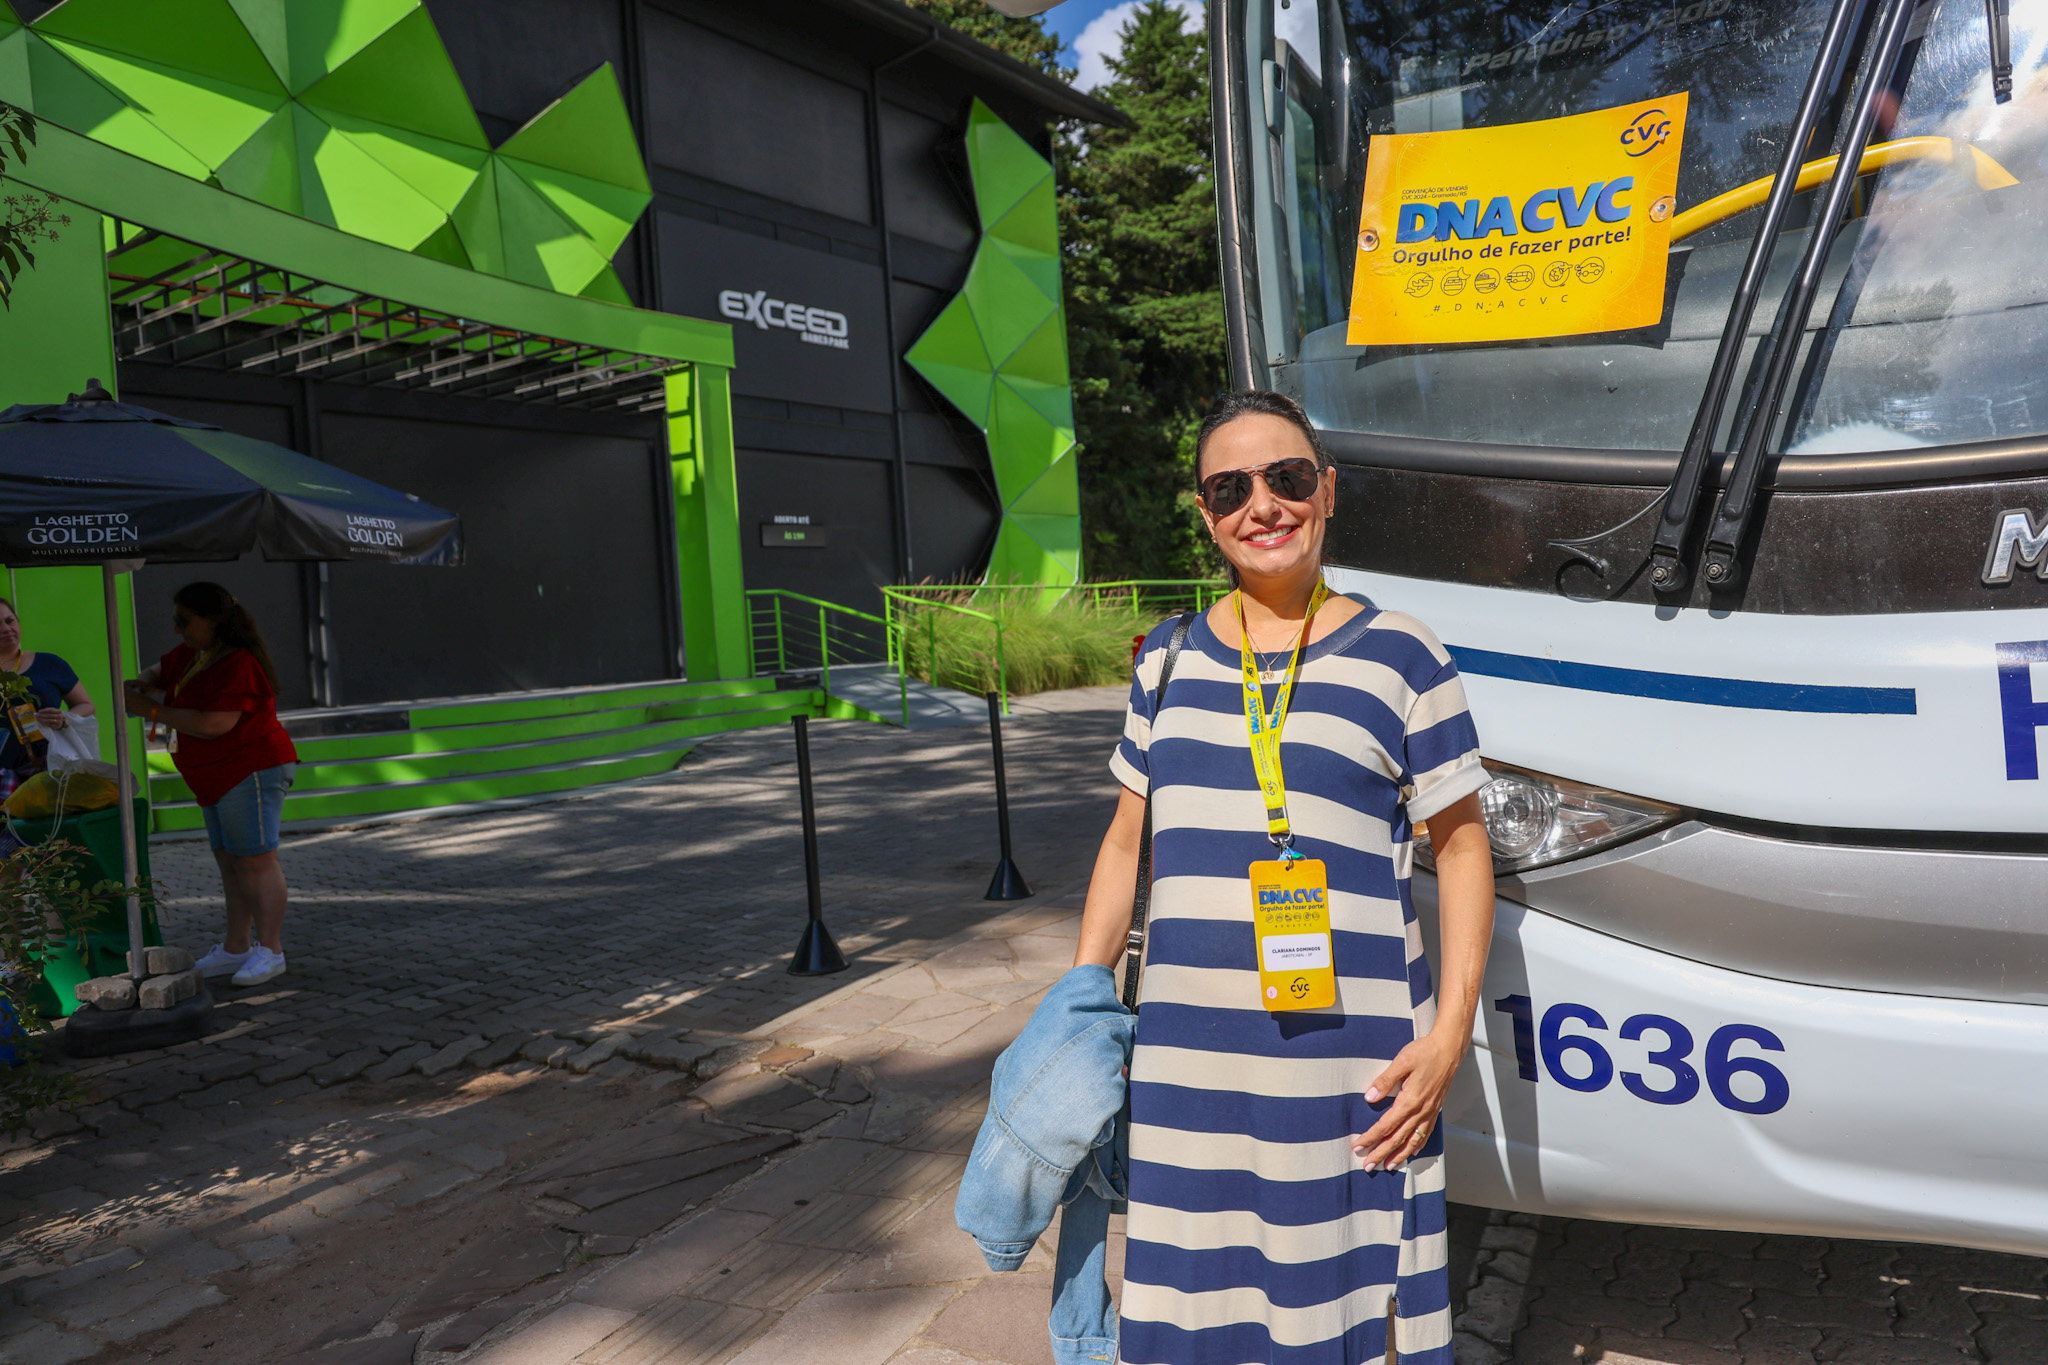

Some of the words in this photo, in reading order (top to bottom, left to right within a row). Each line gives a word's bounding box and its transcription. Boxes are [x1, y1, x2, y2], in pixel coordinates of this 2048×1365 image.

[1620, 120, 1671, 145] CVC
[1393, 242, 1473, 266] Orgulho
[1479, 246, 1502, 259] de
[1510, 236, 1562, 257] fazer
[1569, 226, 1631, 254] parte!
[719, 290, 848, 338] EXCEED
[34, 513, 129, 526] LAGHETTO
[346, 515, 396, 530] LAGHETTO
[27, 526, 138, 545] GOLDEN
[347, 527, 403, 547] GOLDEN
[1290, 983, 1310, 993] CVC
[1494, 993, 1790, 1115] 1636
